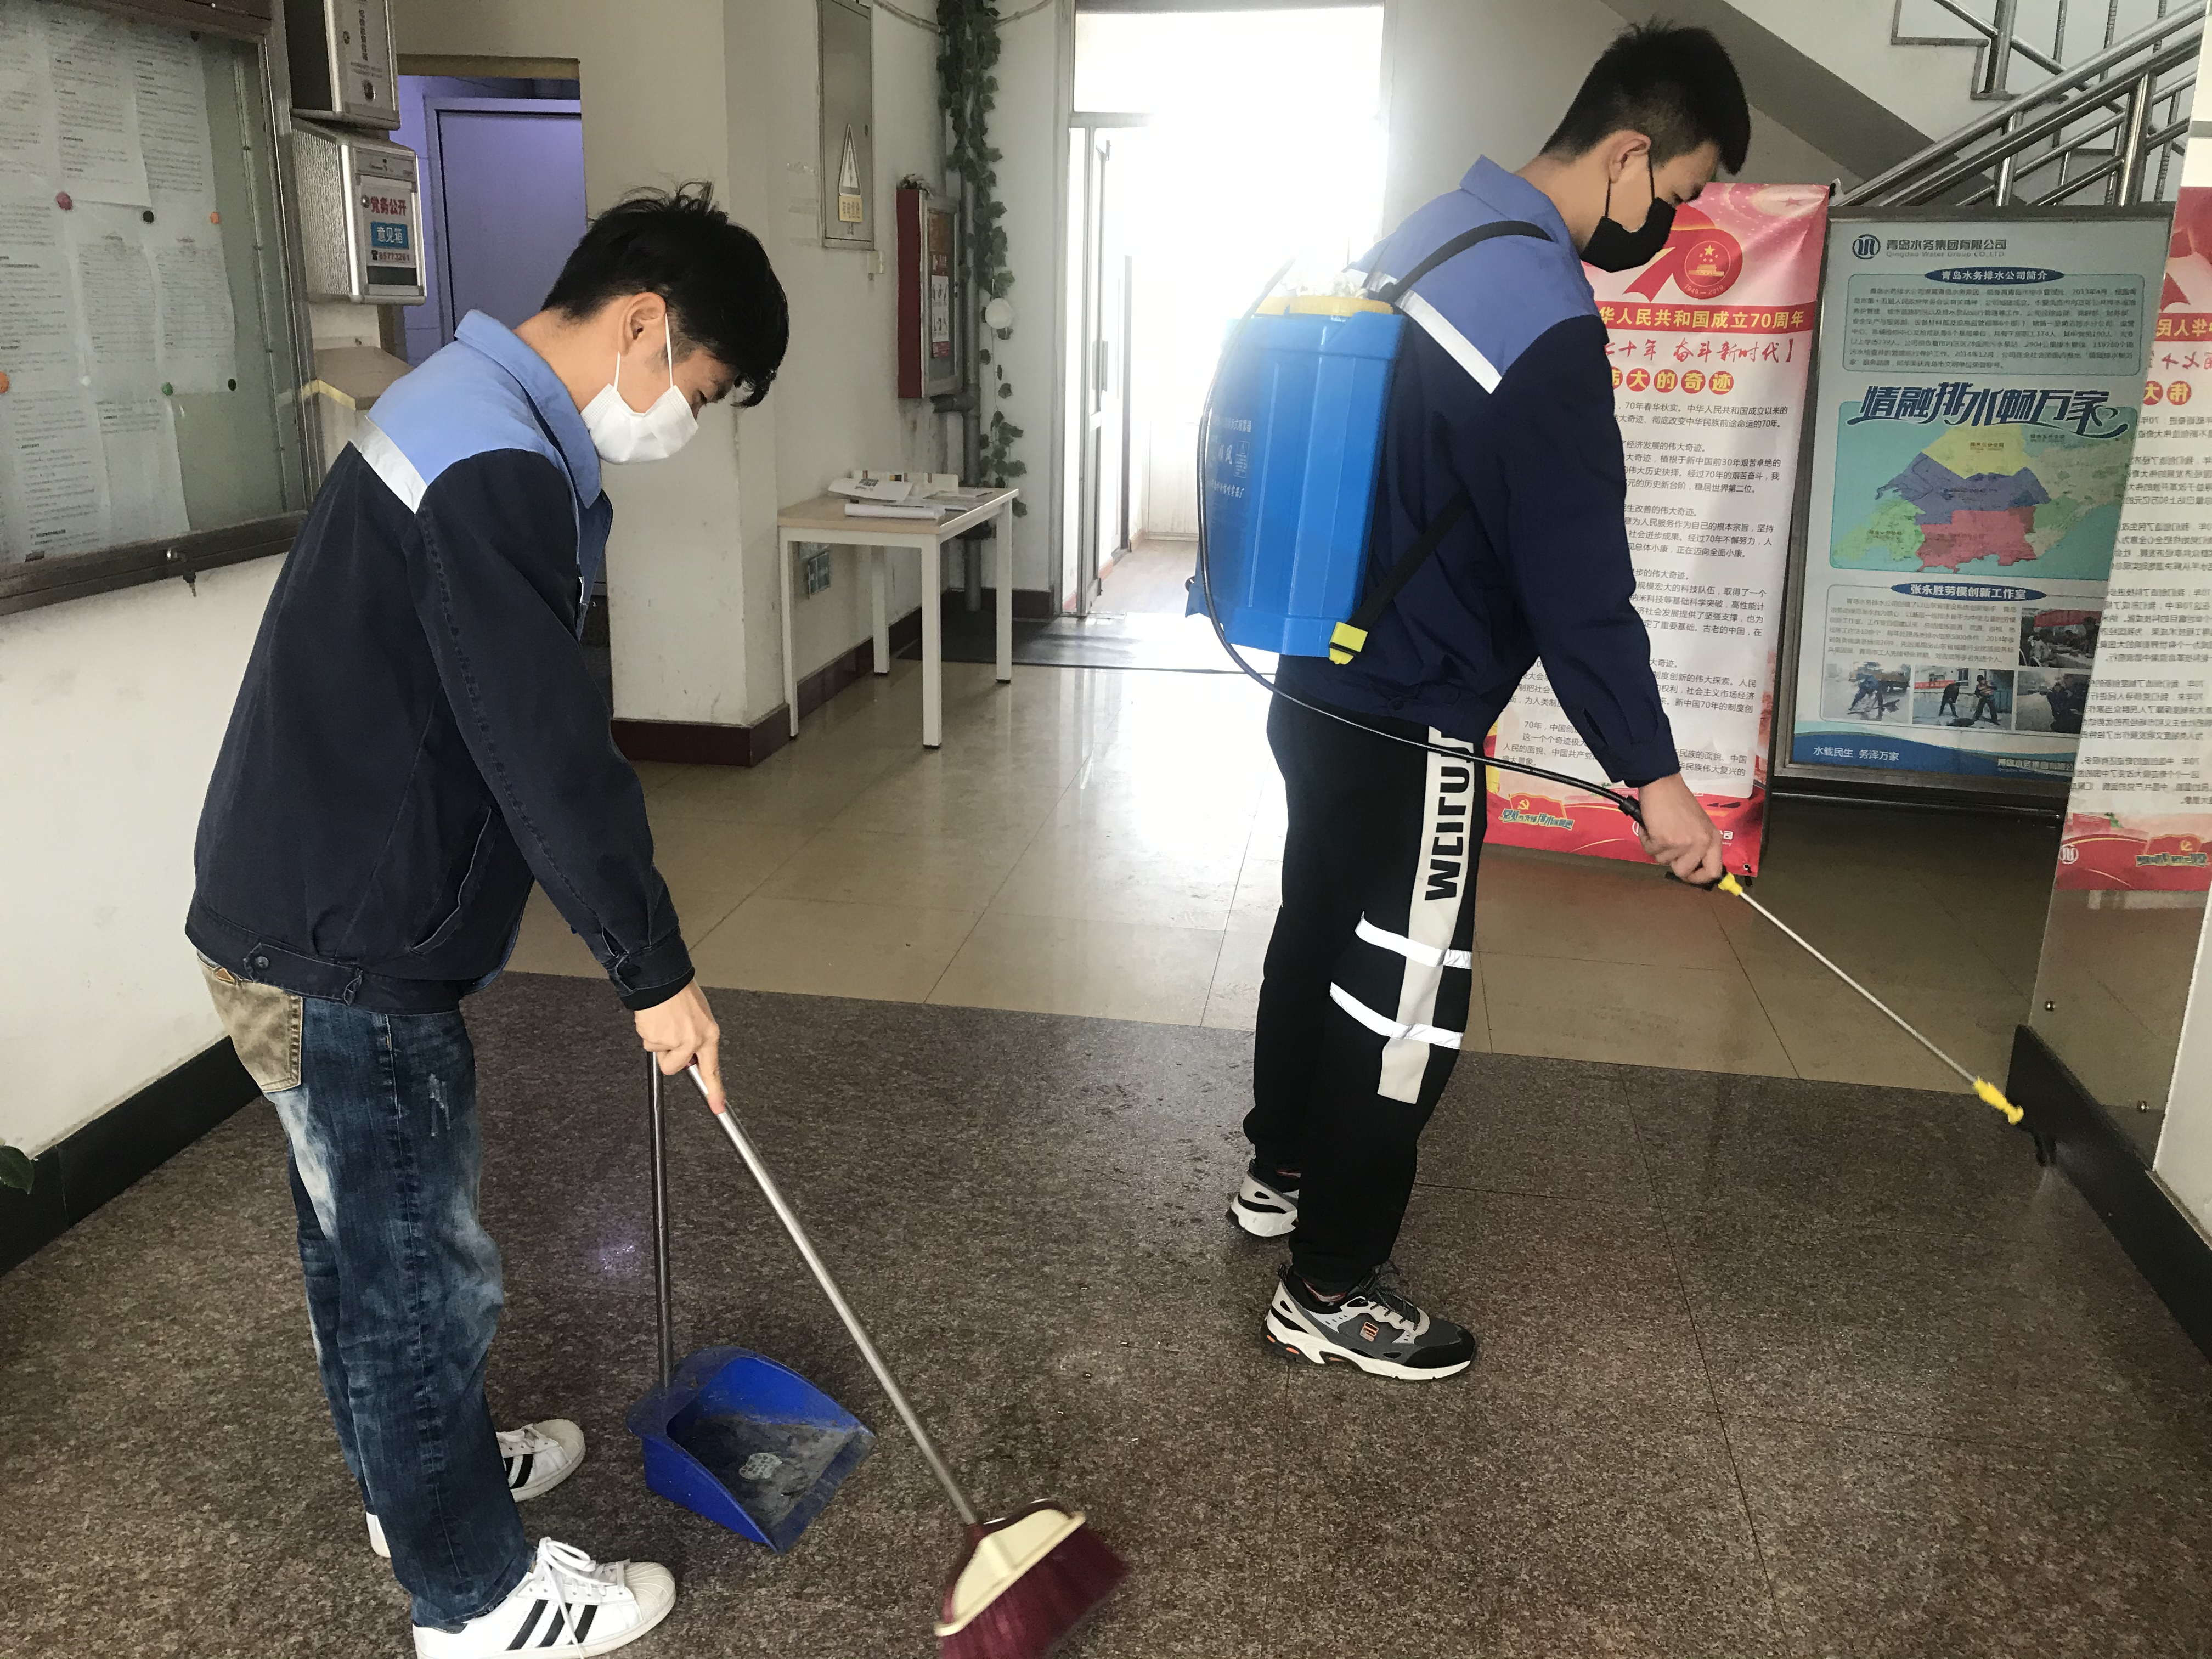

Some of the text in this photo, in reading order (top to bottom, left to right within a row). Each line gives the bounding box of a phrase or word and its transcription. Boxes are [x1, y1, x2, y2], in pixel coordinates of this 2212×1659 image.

[371, 196, 406, 216] 党务公开
[377, 227, 403, 244] 意见箱
[1887, 239, 2007, 250] 青岛水务集团有限公司
[1942, 270, 2047, 281] 青岛水务排水公司简介
[1847, 382, 2129, 439] 情融排水畅万家
[1632, 568, 1689, 580] 步的伟大奇迹。
[1910, 584, 2027, 600] 张永胜劳模创新工作室
[1634, 606, 1763, 624] 济社会发展提供了坚强支撑，也为
[1813, 747, 1899, 761] 水载民生 务泽万家
